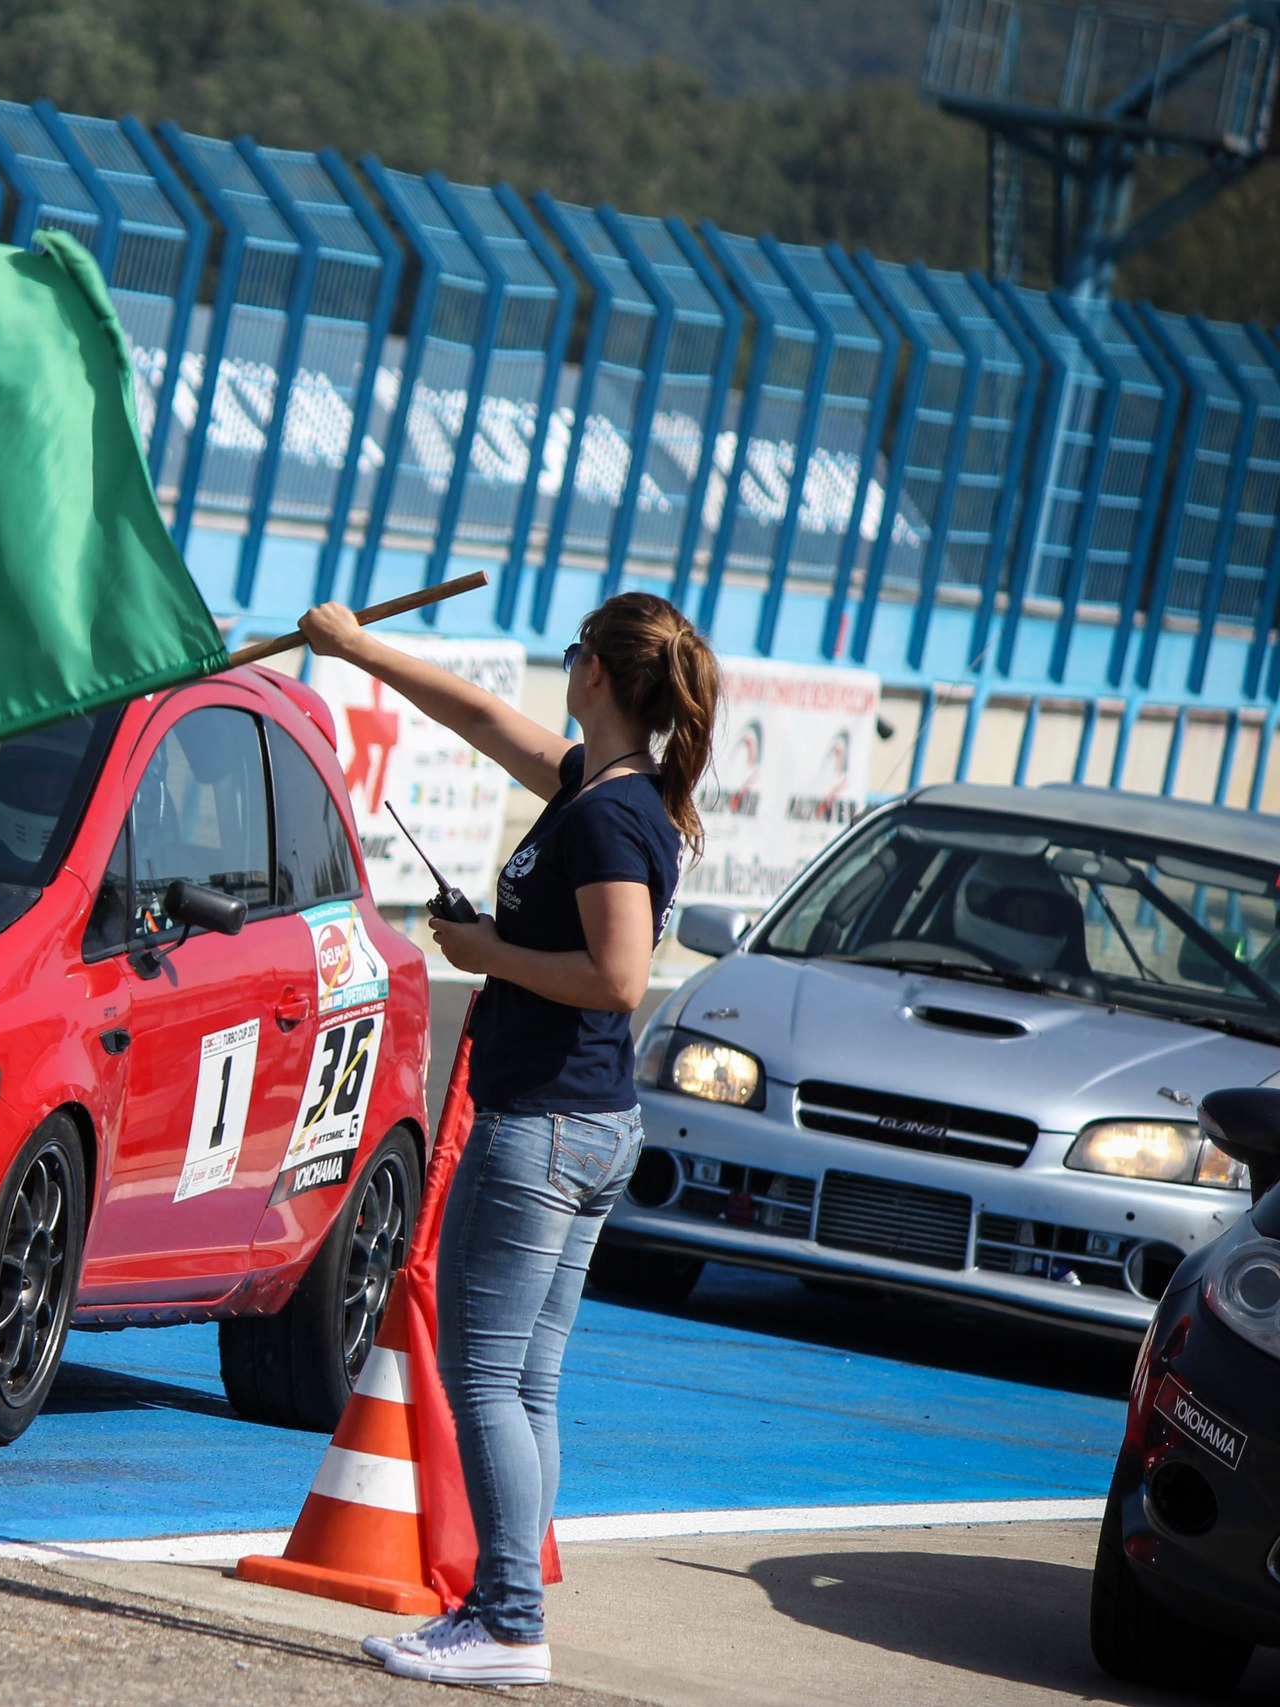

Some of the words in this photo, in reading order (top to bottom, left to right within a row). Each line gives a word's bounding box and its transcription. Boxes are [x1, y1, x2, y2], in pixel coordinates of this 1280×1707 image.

[302, 1018, 375, 1130] 36
[208, 1055, 233, 1150] 1
[880, 1117, 945, 1137] GLANZA
[315, 1128, 346, 1146] ATOMIC
[292, 1155, 344, 1193] YOKOHAMA
[1173, 1395, 1237, 1459] YOKOHAMA
